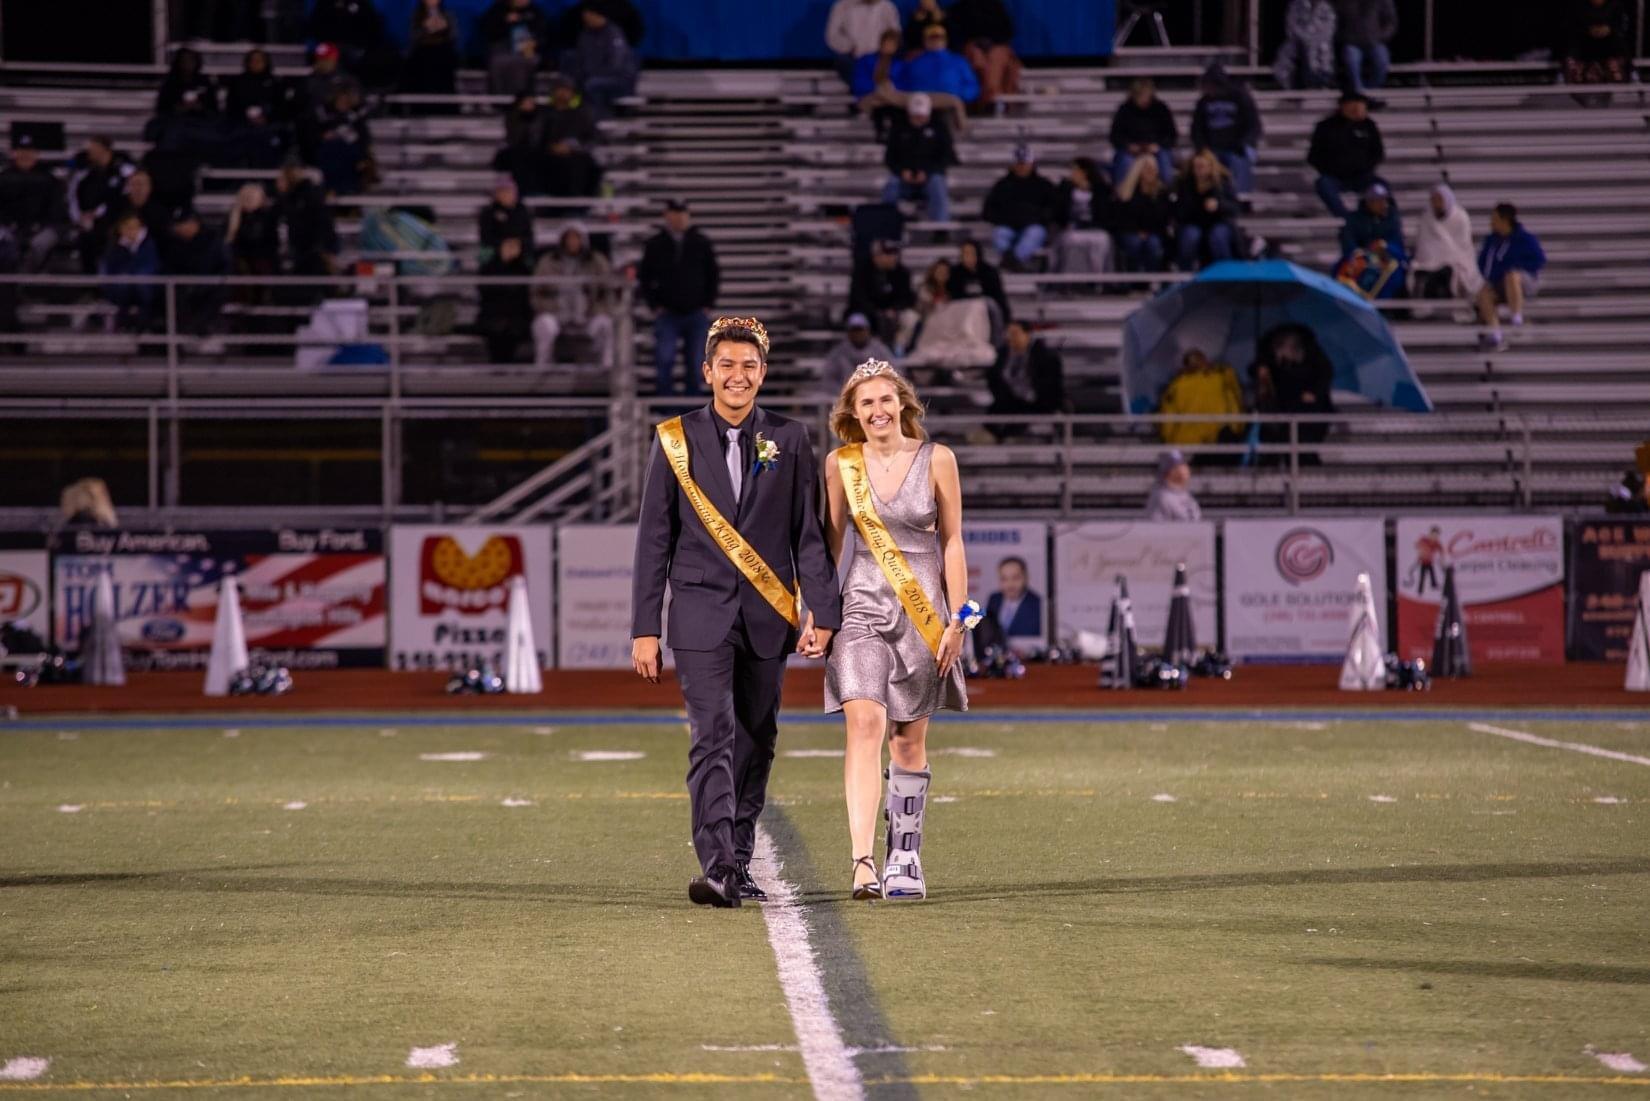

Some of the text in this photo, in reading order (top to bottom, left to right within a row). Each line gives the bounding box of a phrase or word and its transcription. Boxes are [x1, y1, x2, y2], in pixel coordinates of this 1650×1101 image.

[673, 452, 763, 575] Homecoming King 2018
[76, 531, 115, 555] Buy
[278, 530, 316, 554] Buy
[851, 475, 929, 614] Homecoming Queen 2018
[1456, 560, 1494, 575] arpet
